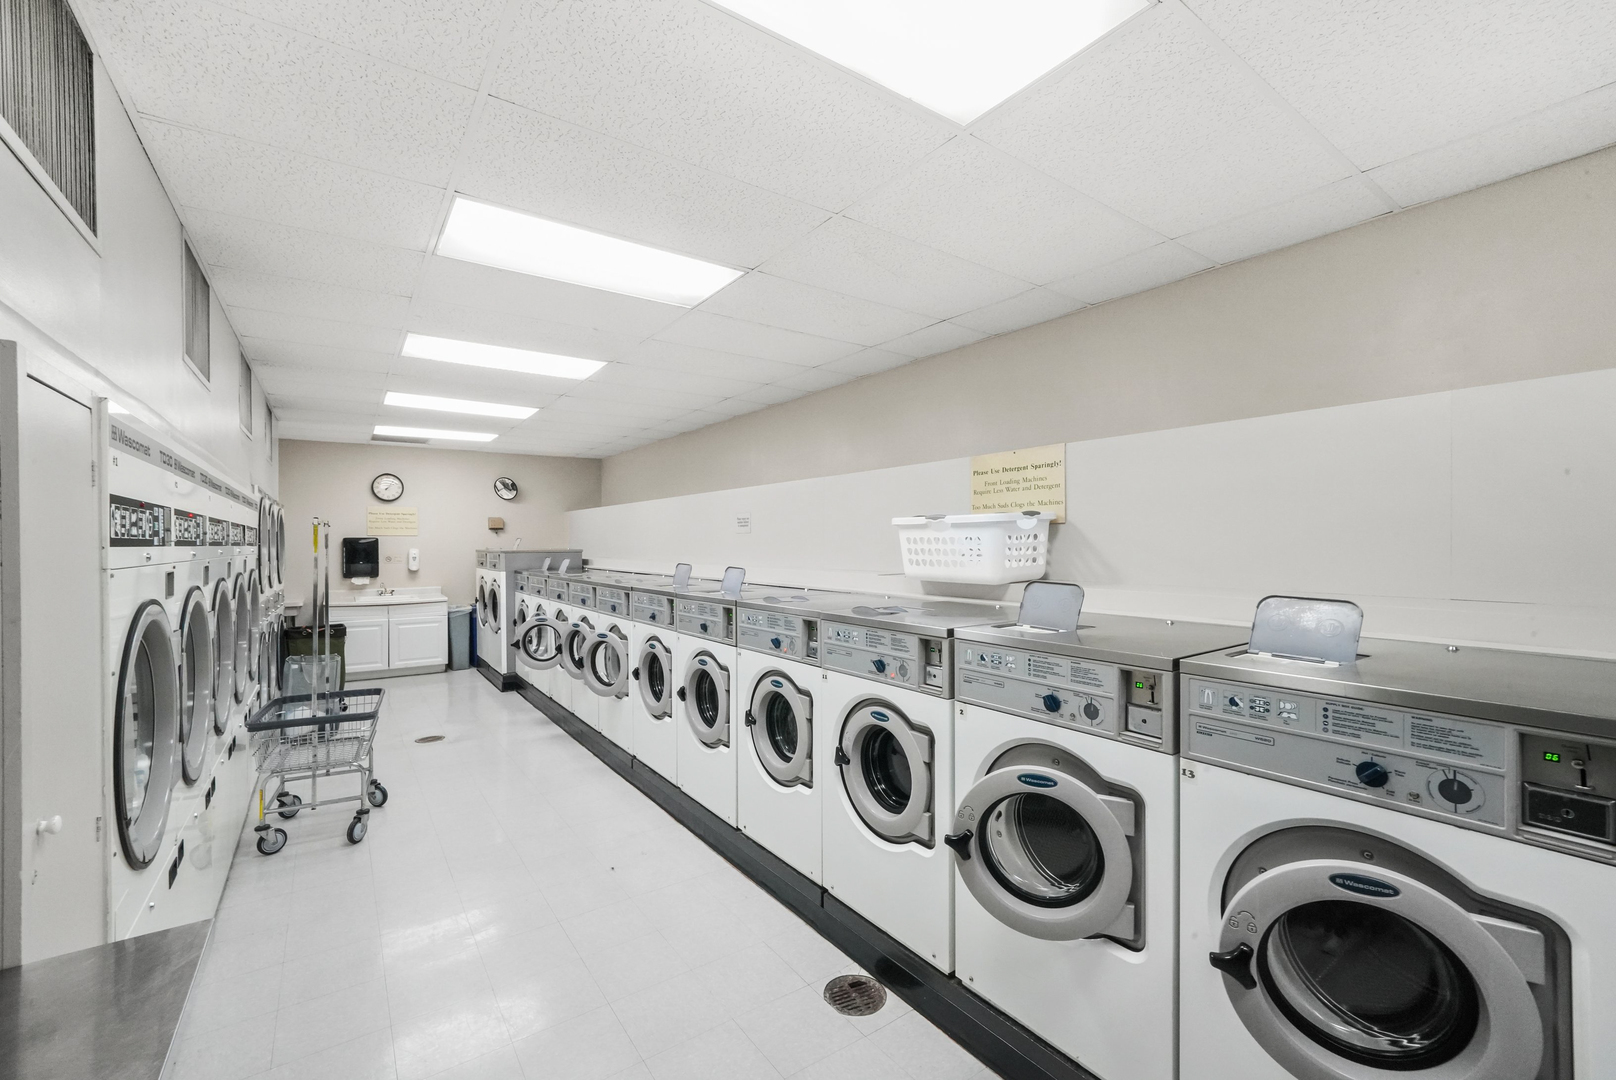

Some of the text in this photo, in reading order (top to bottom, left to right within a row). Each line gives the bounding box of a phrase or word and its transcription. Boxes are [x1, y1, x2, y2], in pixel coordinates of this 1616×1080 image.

[117, 428, 150, 456] Wascomat
[1002, 464, 1028, 473] Detergent
[1031, 460, 1062, 470] Sparingly!
[1182, 768, 1195, 779] 13
[1344, 880, 1394, 894] Wascomat
